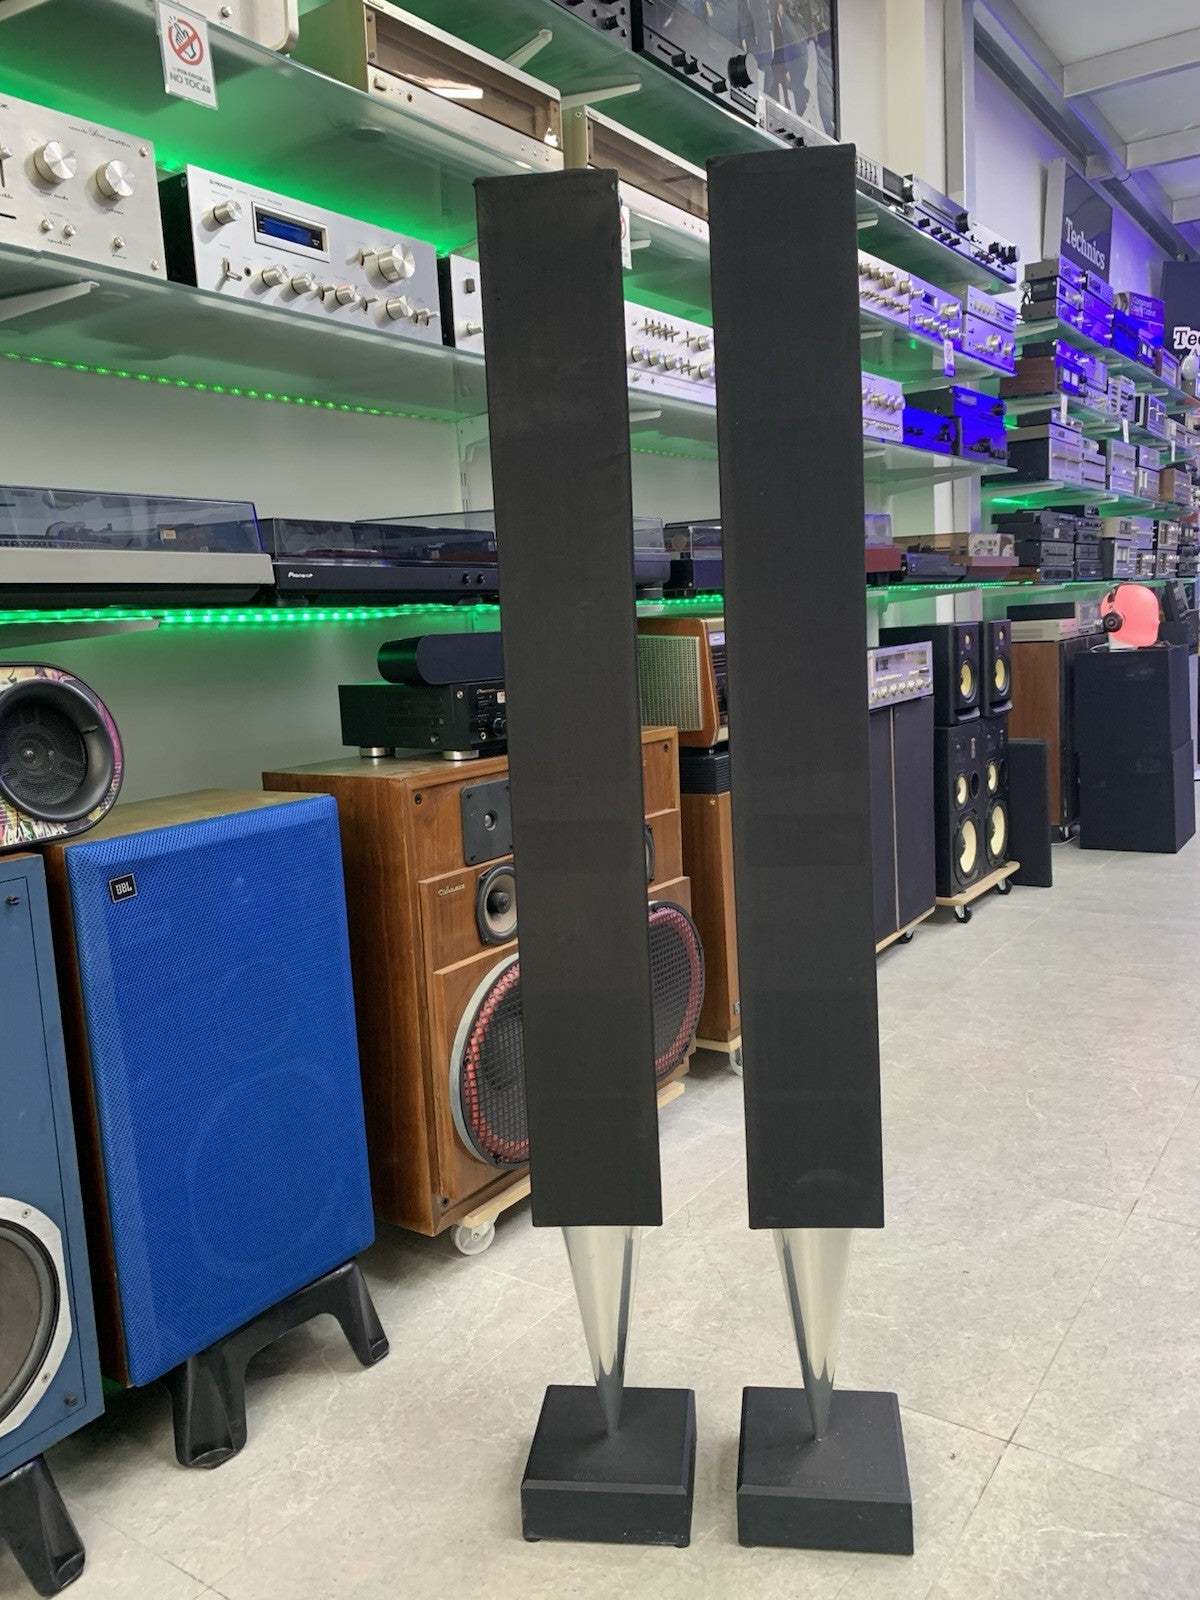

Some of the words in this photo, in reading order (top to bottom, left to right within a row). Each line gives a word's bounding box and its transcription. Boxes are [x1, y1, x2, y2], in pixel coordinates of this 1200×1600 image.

[169, 72, 183, 83] NO
[184, 77, 211, 94] TOCAR
[1065, 216, 1105, 270] Technics
[1173, 328, 1200, 348] Te
[115, 881, 133, 895] JBL
